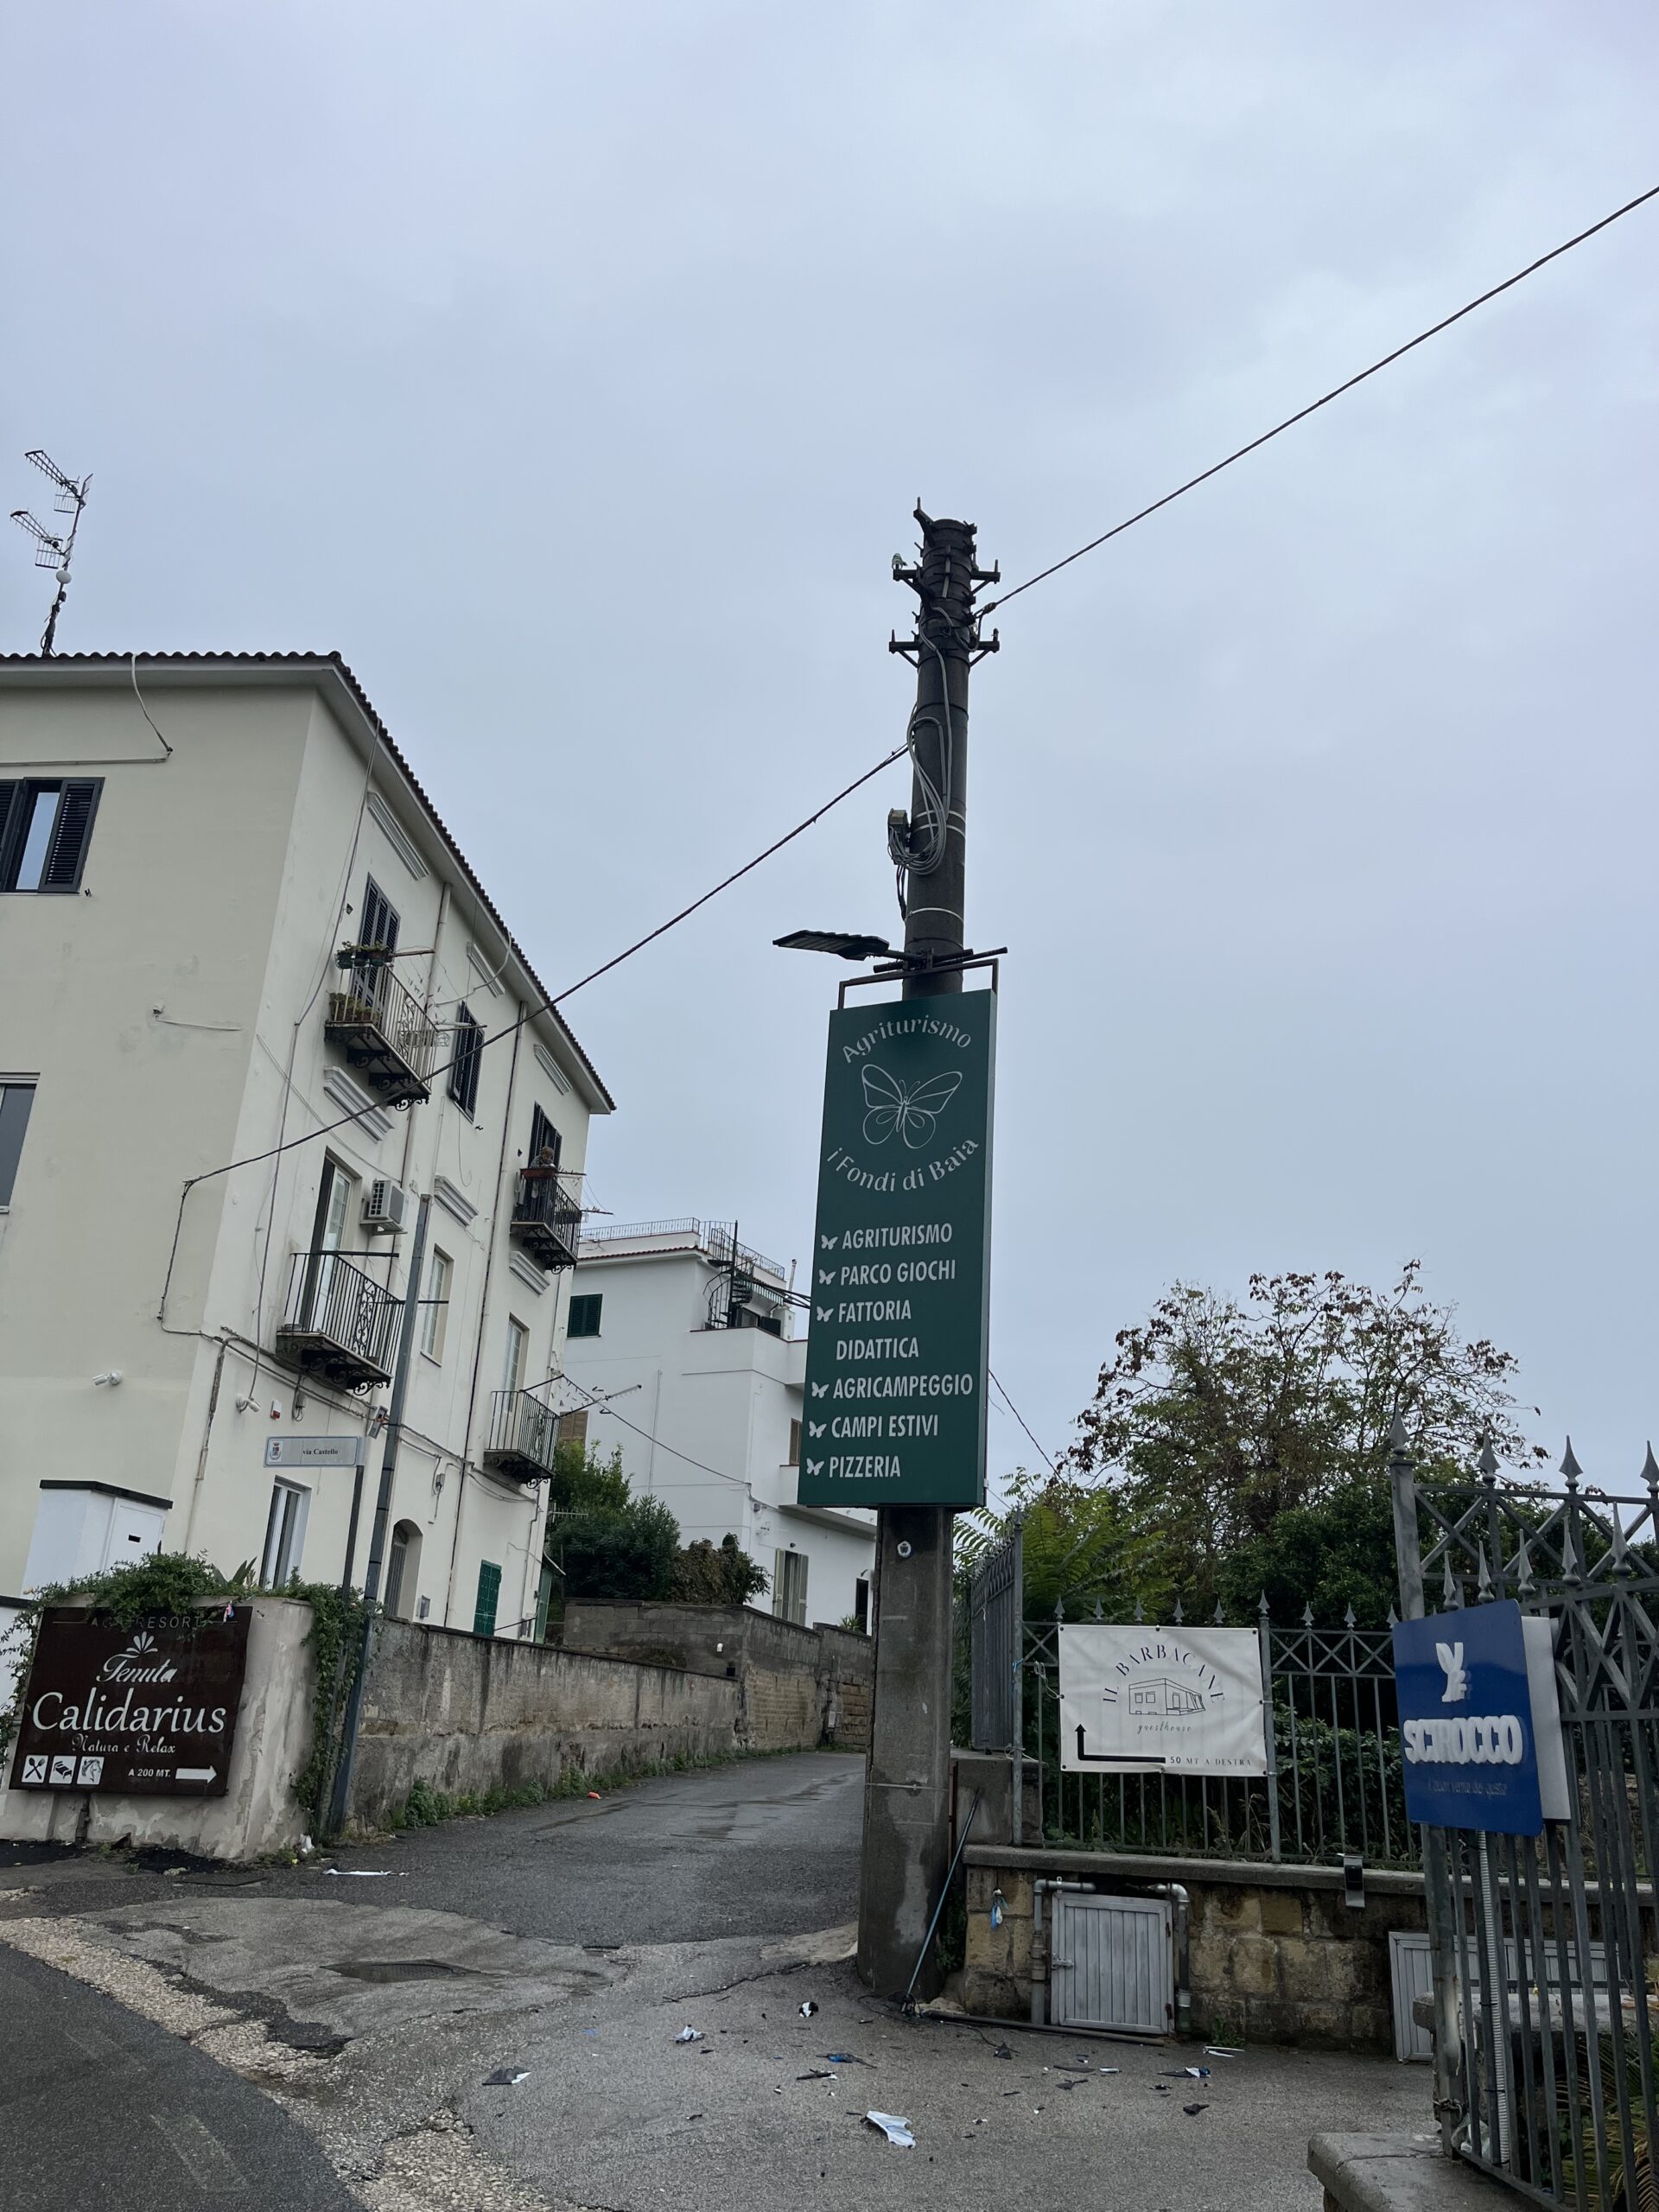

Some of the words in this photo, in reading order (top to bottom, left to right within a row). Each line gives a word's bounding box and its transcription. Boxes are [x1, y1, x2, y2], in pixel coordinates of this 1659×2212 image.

[842, 1014, 971, 1063] Agriturismo
[827, 1147, 842, 1161] i
[836, 1155, 896, 1192] Fondi
[903, 1168, 925, 1191] di
[929, 1140, 979, 1181] Baia
[842, 1224, 952, 1249] AGRITURISMO
[840, 1264, 892, 1286] PARCO
[897, 1260, 956, 1282] GIOCHI
[838, 1300, 912, 1323] FATTORIA
[836, 1338, 919, 1360] DIDATTICA
[833, 1374, 974, 1399] AGRICAMPEGGIO
[831, 1416, 882, 1438] CAMPI
[888, 1414, 938, 1437] ESTIVI
[829, 1456, 901, 1478] PIZZERIA
[96, 1653, 178, 1682] Tenuta
[1103, 1688, 1119, 1703] IL
[1115, 1644, 1225, 1704] BARBACANE
[32, 1687, 227, 1733] Calidarius
[1137, 1721, 1192, 1735] guesthouse
[1403, 1715, 1522, 1764] SCIROCCO
[72, 1733, 118, 1752] Natura
[136, 1734, 176, 1753] Relax
[1170, 1756, 1181, 1764] 50
[137, 1769, 154, 1777] 200
[156, 1769, 171, 1777] MT.
